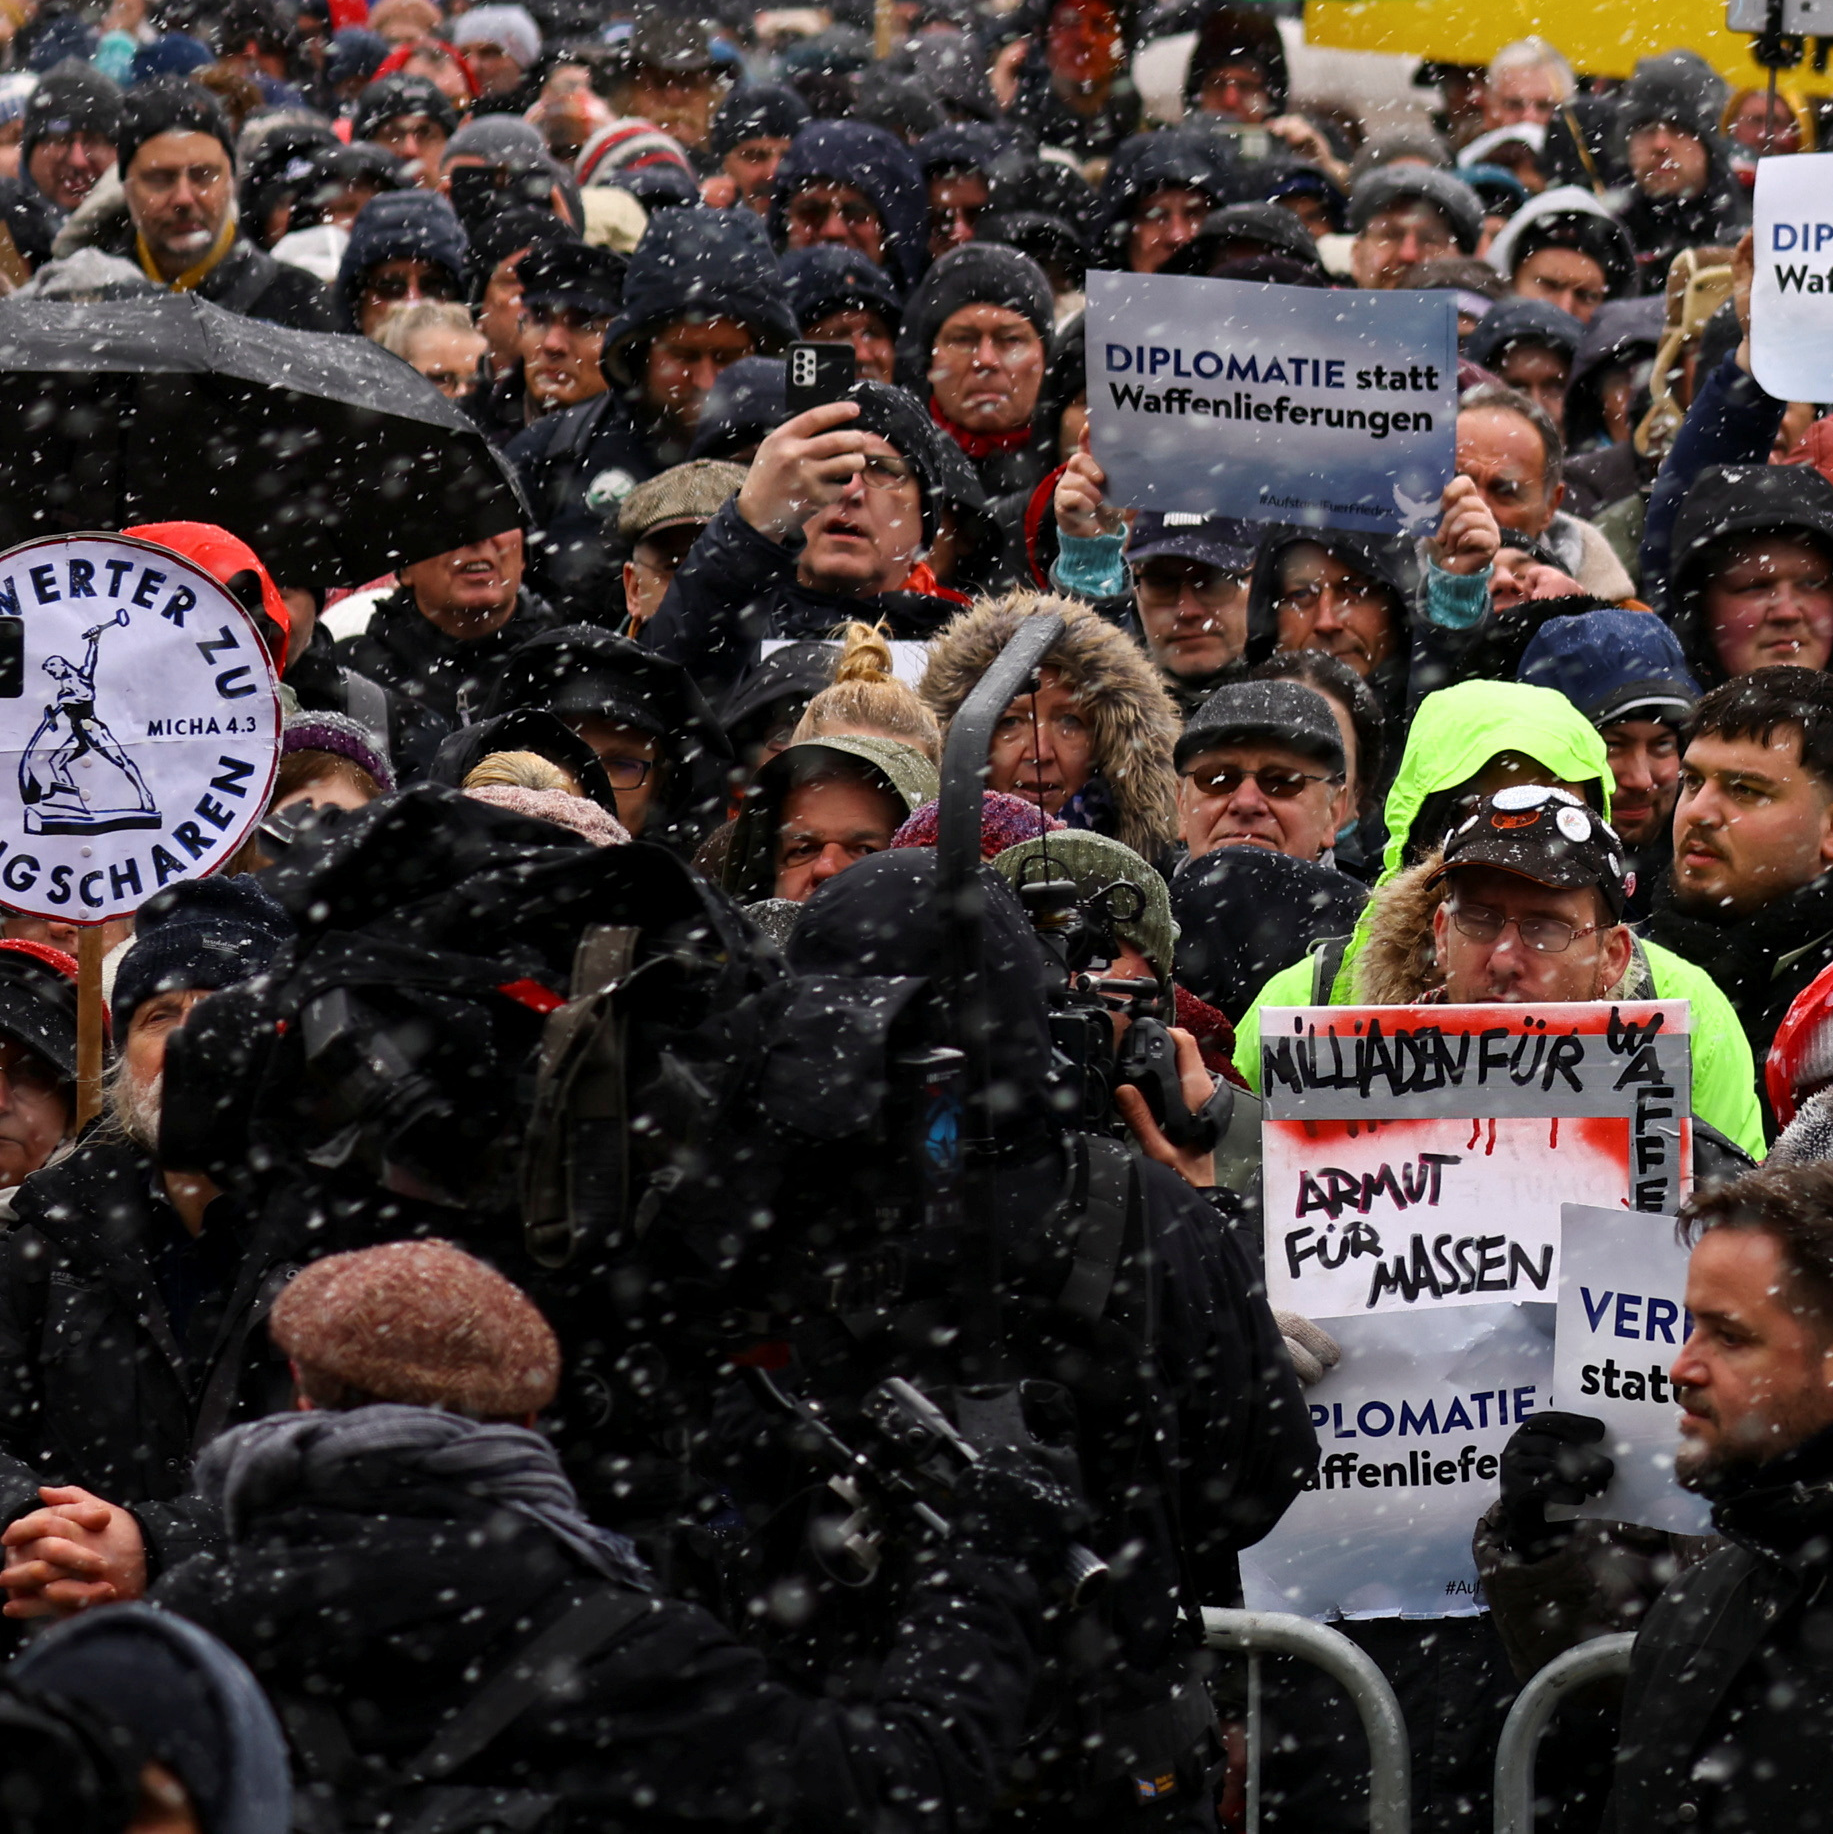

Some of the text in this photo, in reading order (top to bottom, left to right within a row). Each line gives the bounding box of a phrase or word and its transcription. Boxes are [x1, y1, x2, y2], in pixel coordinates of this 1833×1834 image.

[1105, 343, 1440, 392] DIPLOMATIE statt
[1109, 381, 1434, 440] Waffenlieferungen
[196, 625, 258, 700] ZU
[147, 715, 258, 738] MICHA 4.3
[0, 755, 256, 908] GSCHAREN
[1478, 1014, 1585, 1093] FÜR
[1295, 1152, 1463, 1221] ARMUT
[1285, 1220, 1554, 1309] FÜR MASSEN
